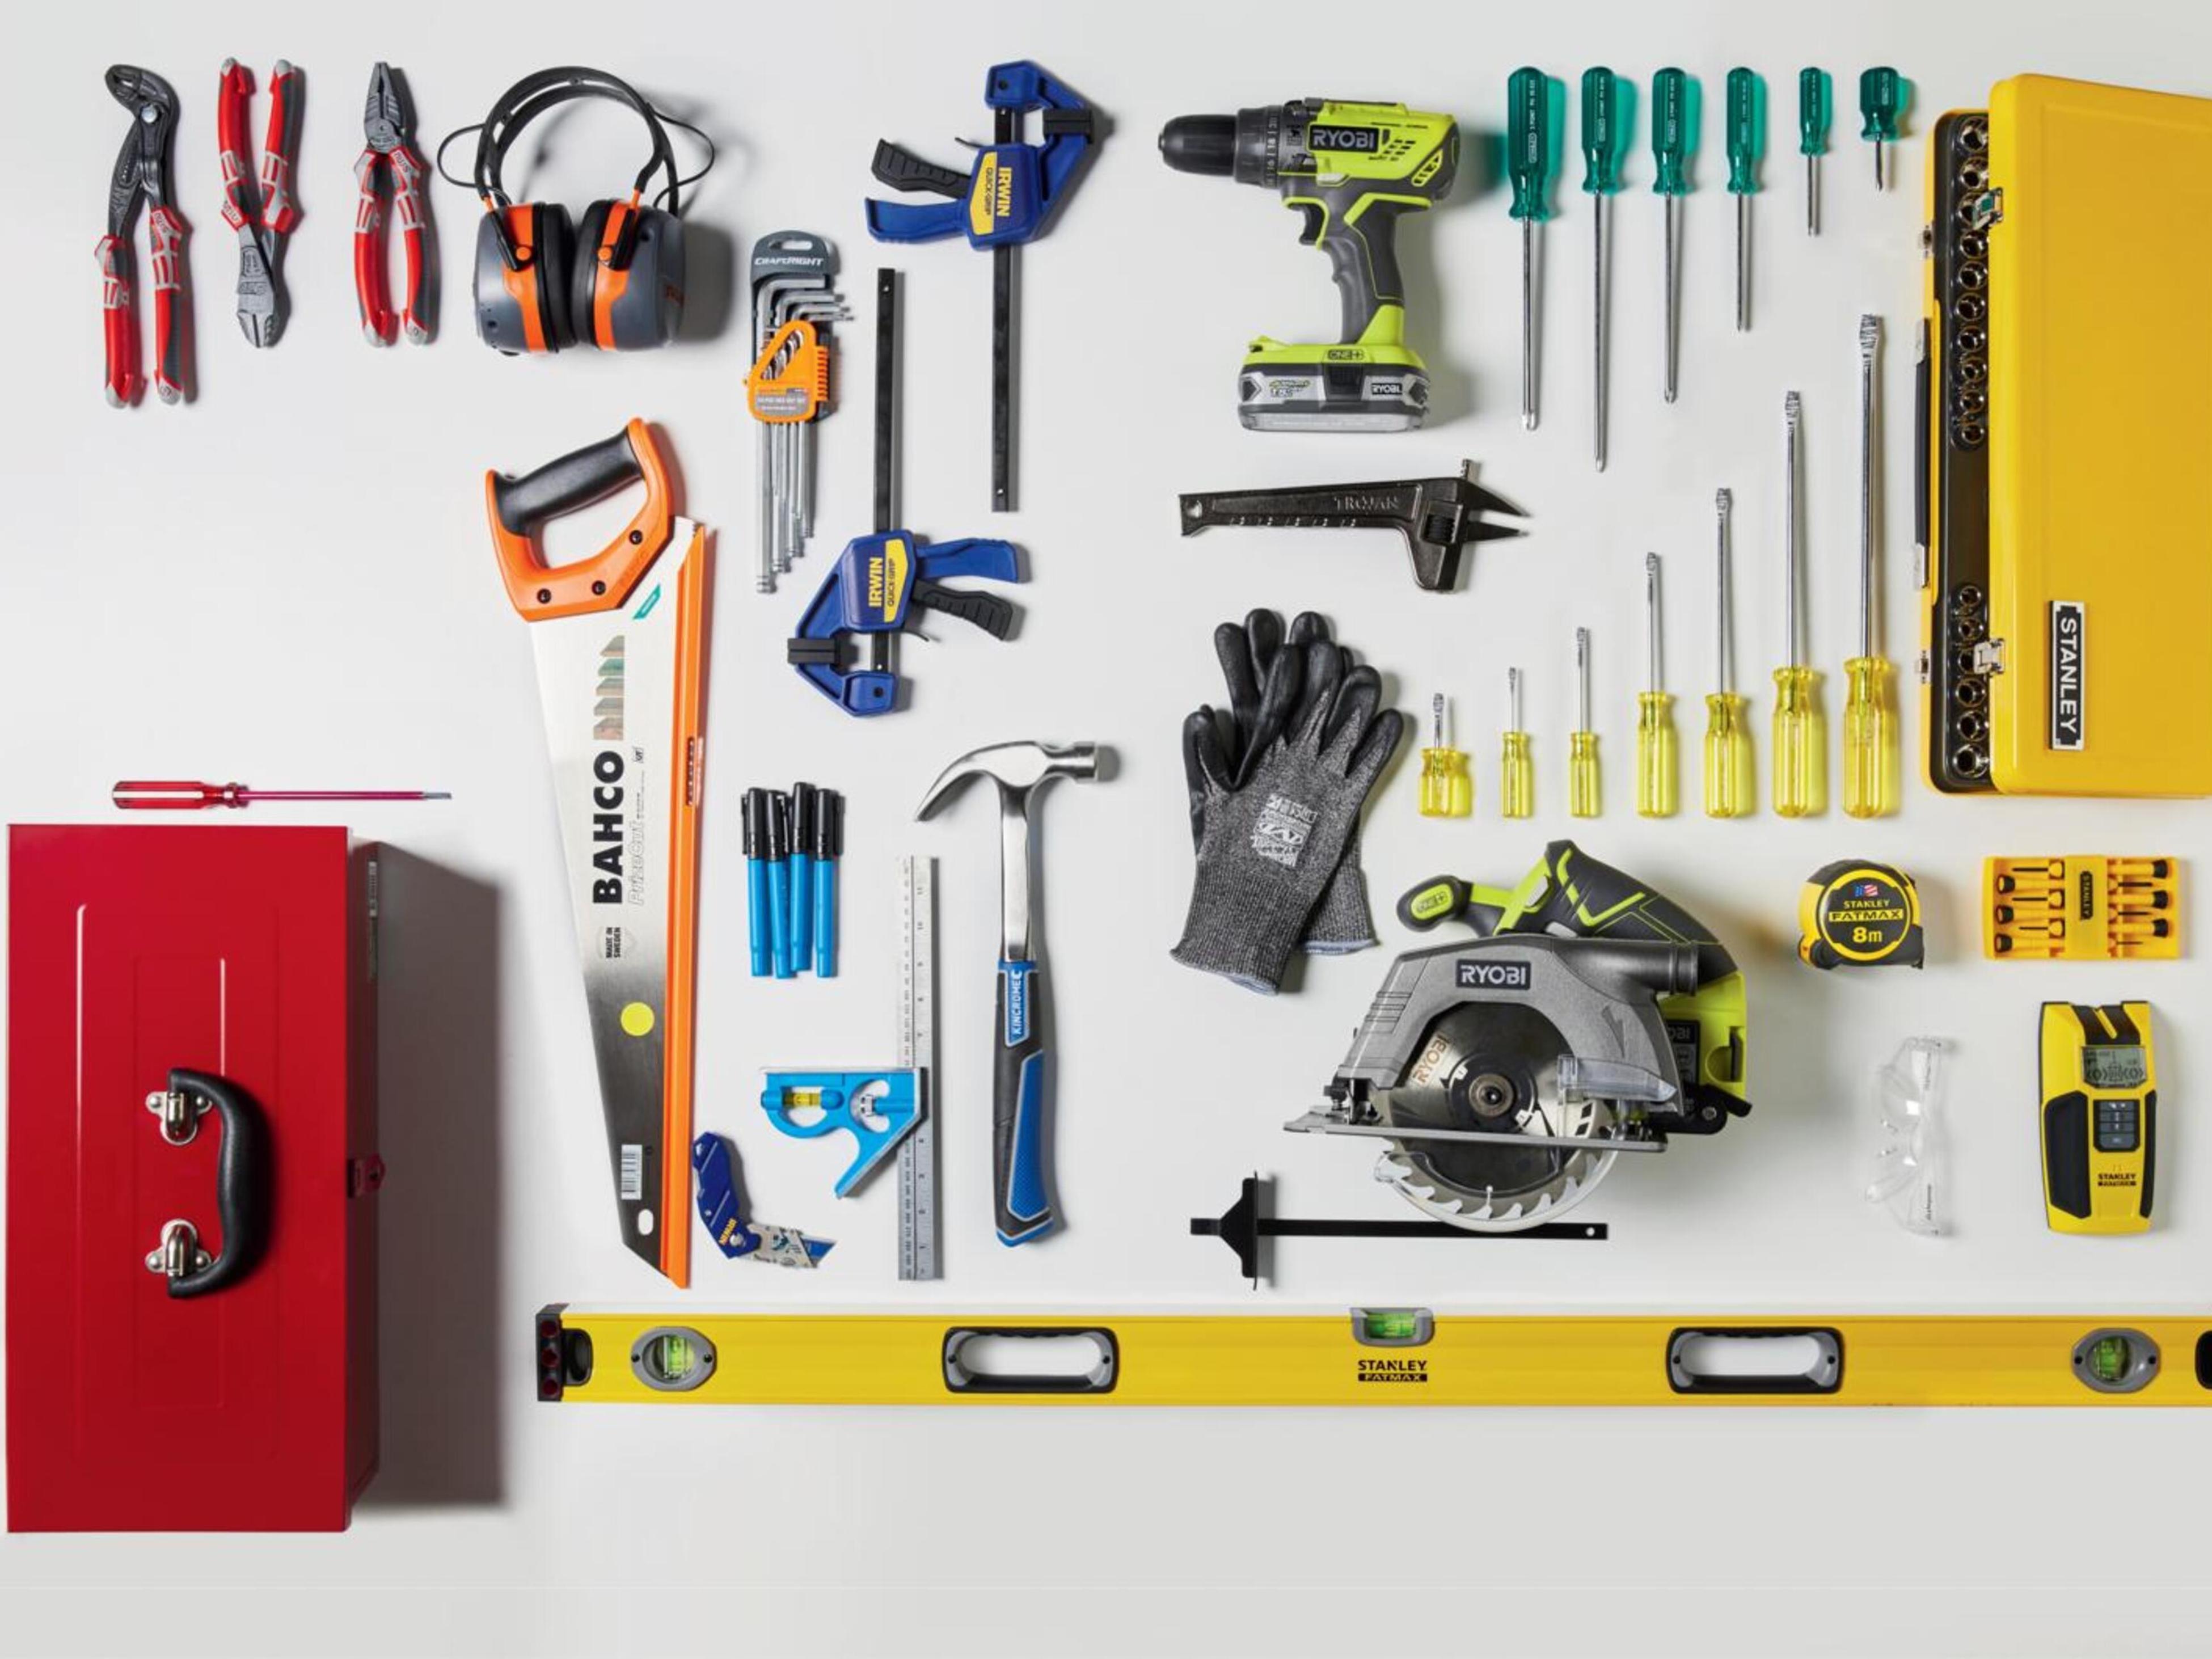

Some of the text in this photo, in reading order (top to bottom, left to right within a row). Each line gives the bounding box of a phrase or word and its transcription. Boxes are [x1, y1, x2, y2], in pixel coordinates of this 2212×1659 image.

[1312, 129, 1375, 149] RYOBI
[997, 167, 1012, 216] IRWIN
[1371, 383, 1402, 394] RYOBI
[869, 558, 883, 607] IRWIN
[2060, 617, 2077, 734] STANLEY
[593, 750, 624, 904] BAHCO
[1844, 900, 1890, 909] STANLEY
[1832, 911, 1900, 920] FATMAX
[1852, 927, 1882, 943] 8m
[1460, 965, 1526, 985] RYOBI
[1413, 1033, 1450, 1084] RYOBI
[1358, 1360, 1428, 1370] STANLEY
